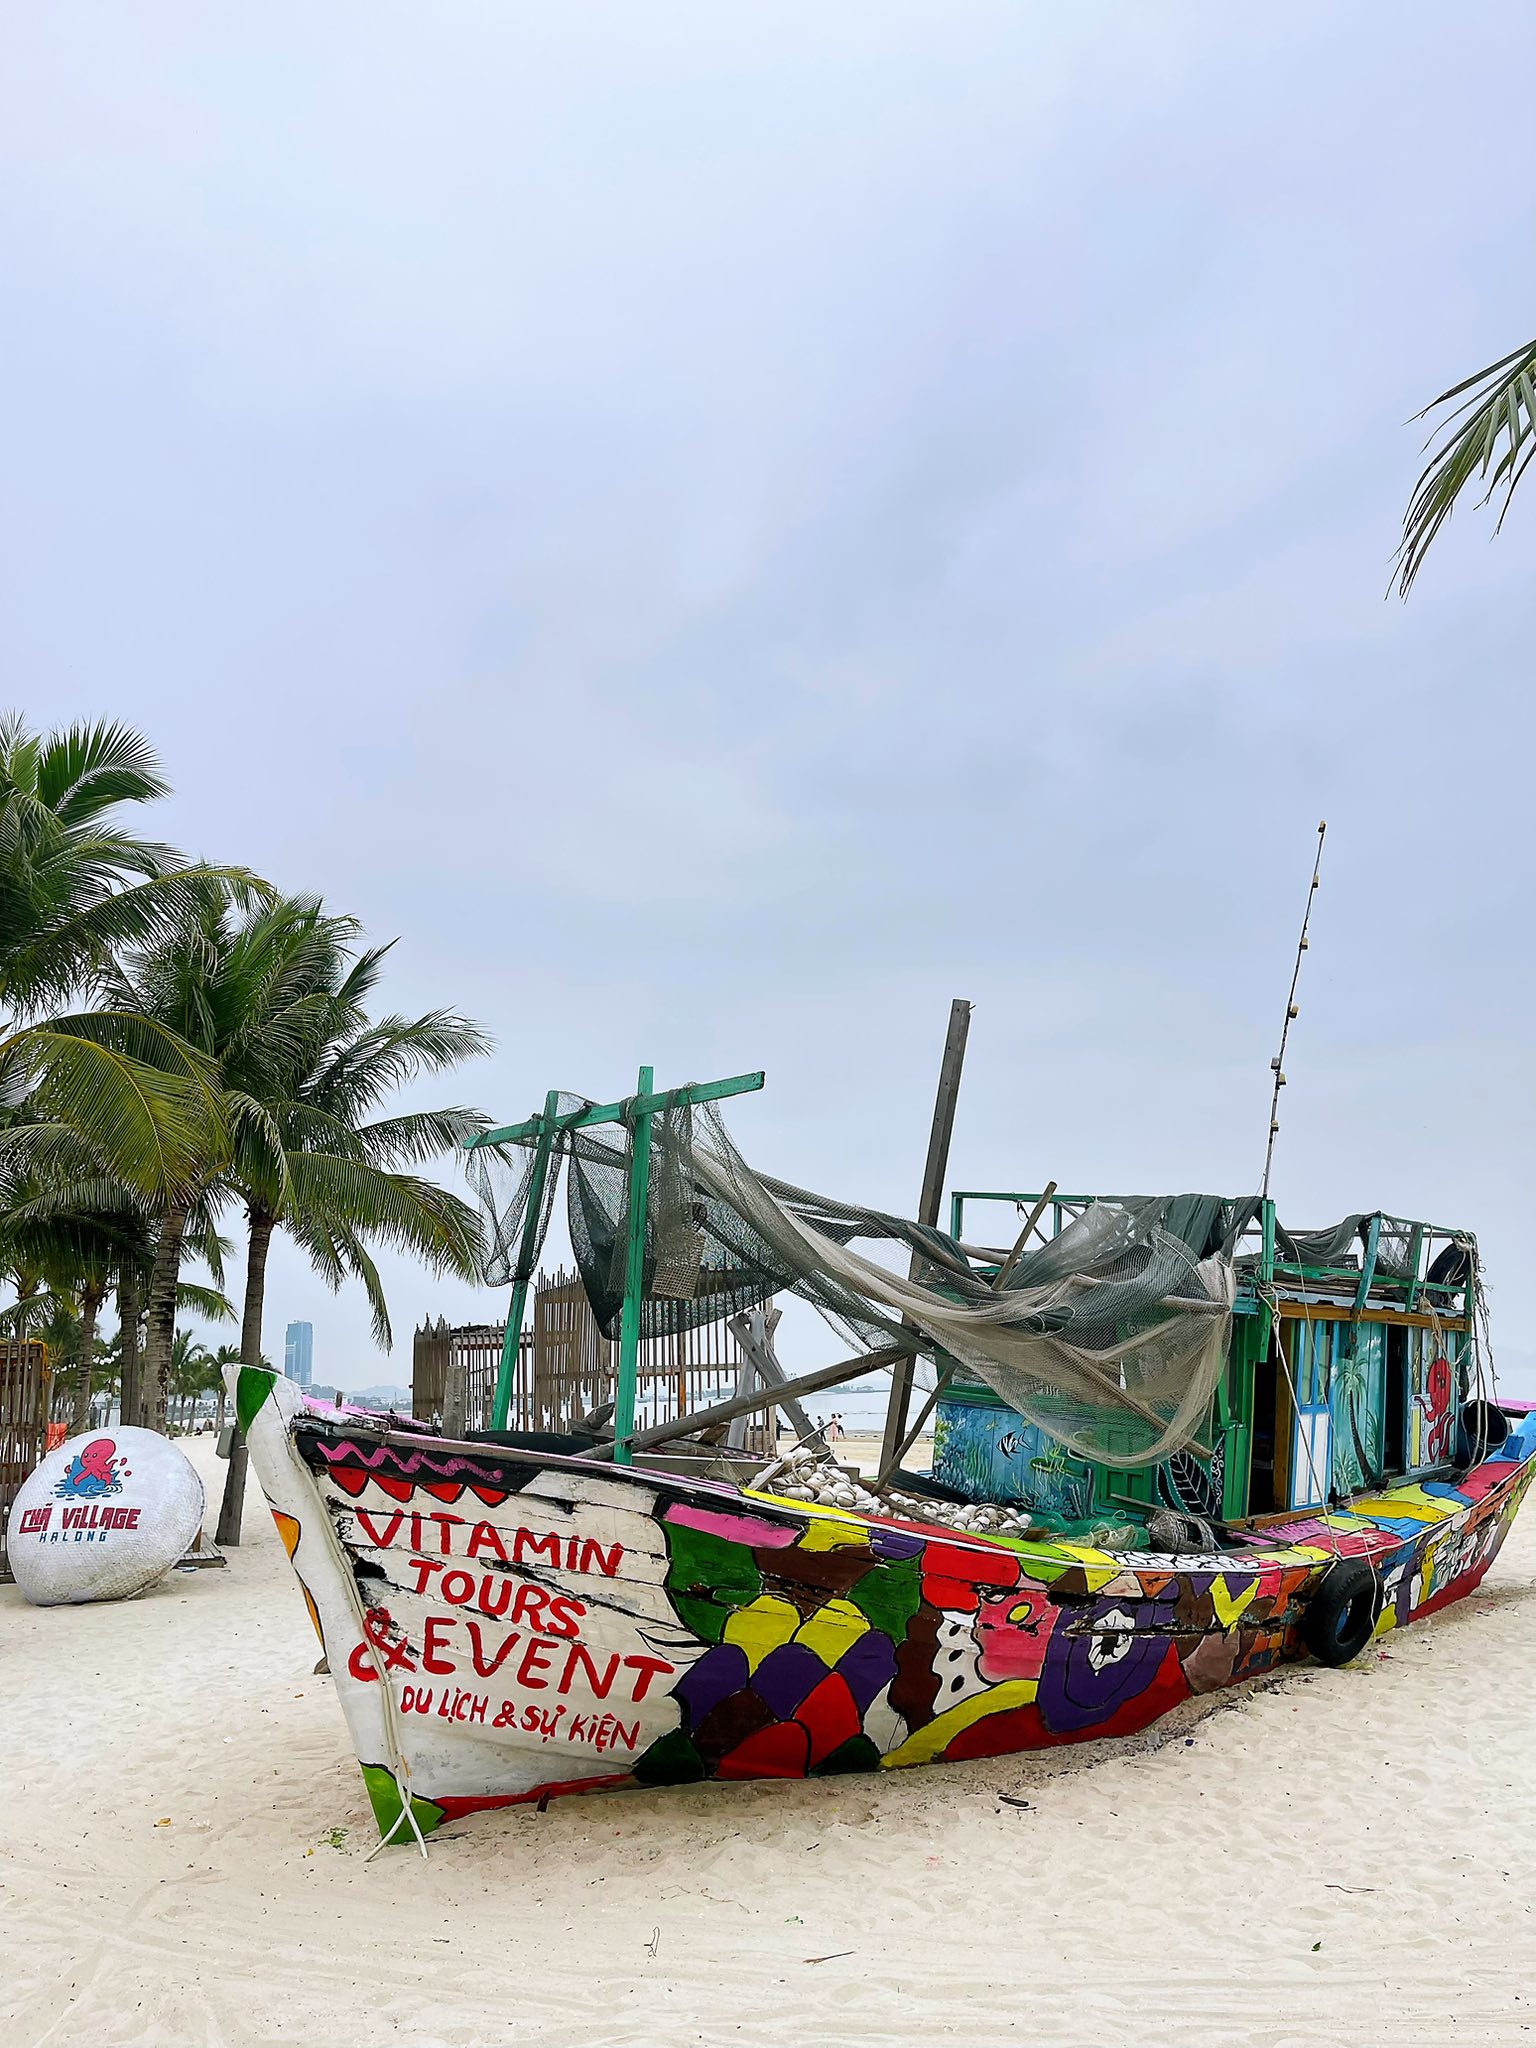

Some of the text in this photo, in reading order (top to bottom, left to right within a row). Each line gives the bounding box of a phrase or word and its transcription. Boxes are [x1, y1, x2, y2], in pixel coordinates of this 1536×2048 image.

[355, 1506, 624, 1577] VITAMIN
[409, 1559, 587, 1639] TOURS
[401, 1685, 433, 1714] DU
